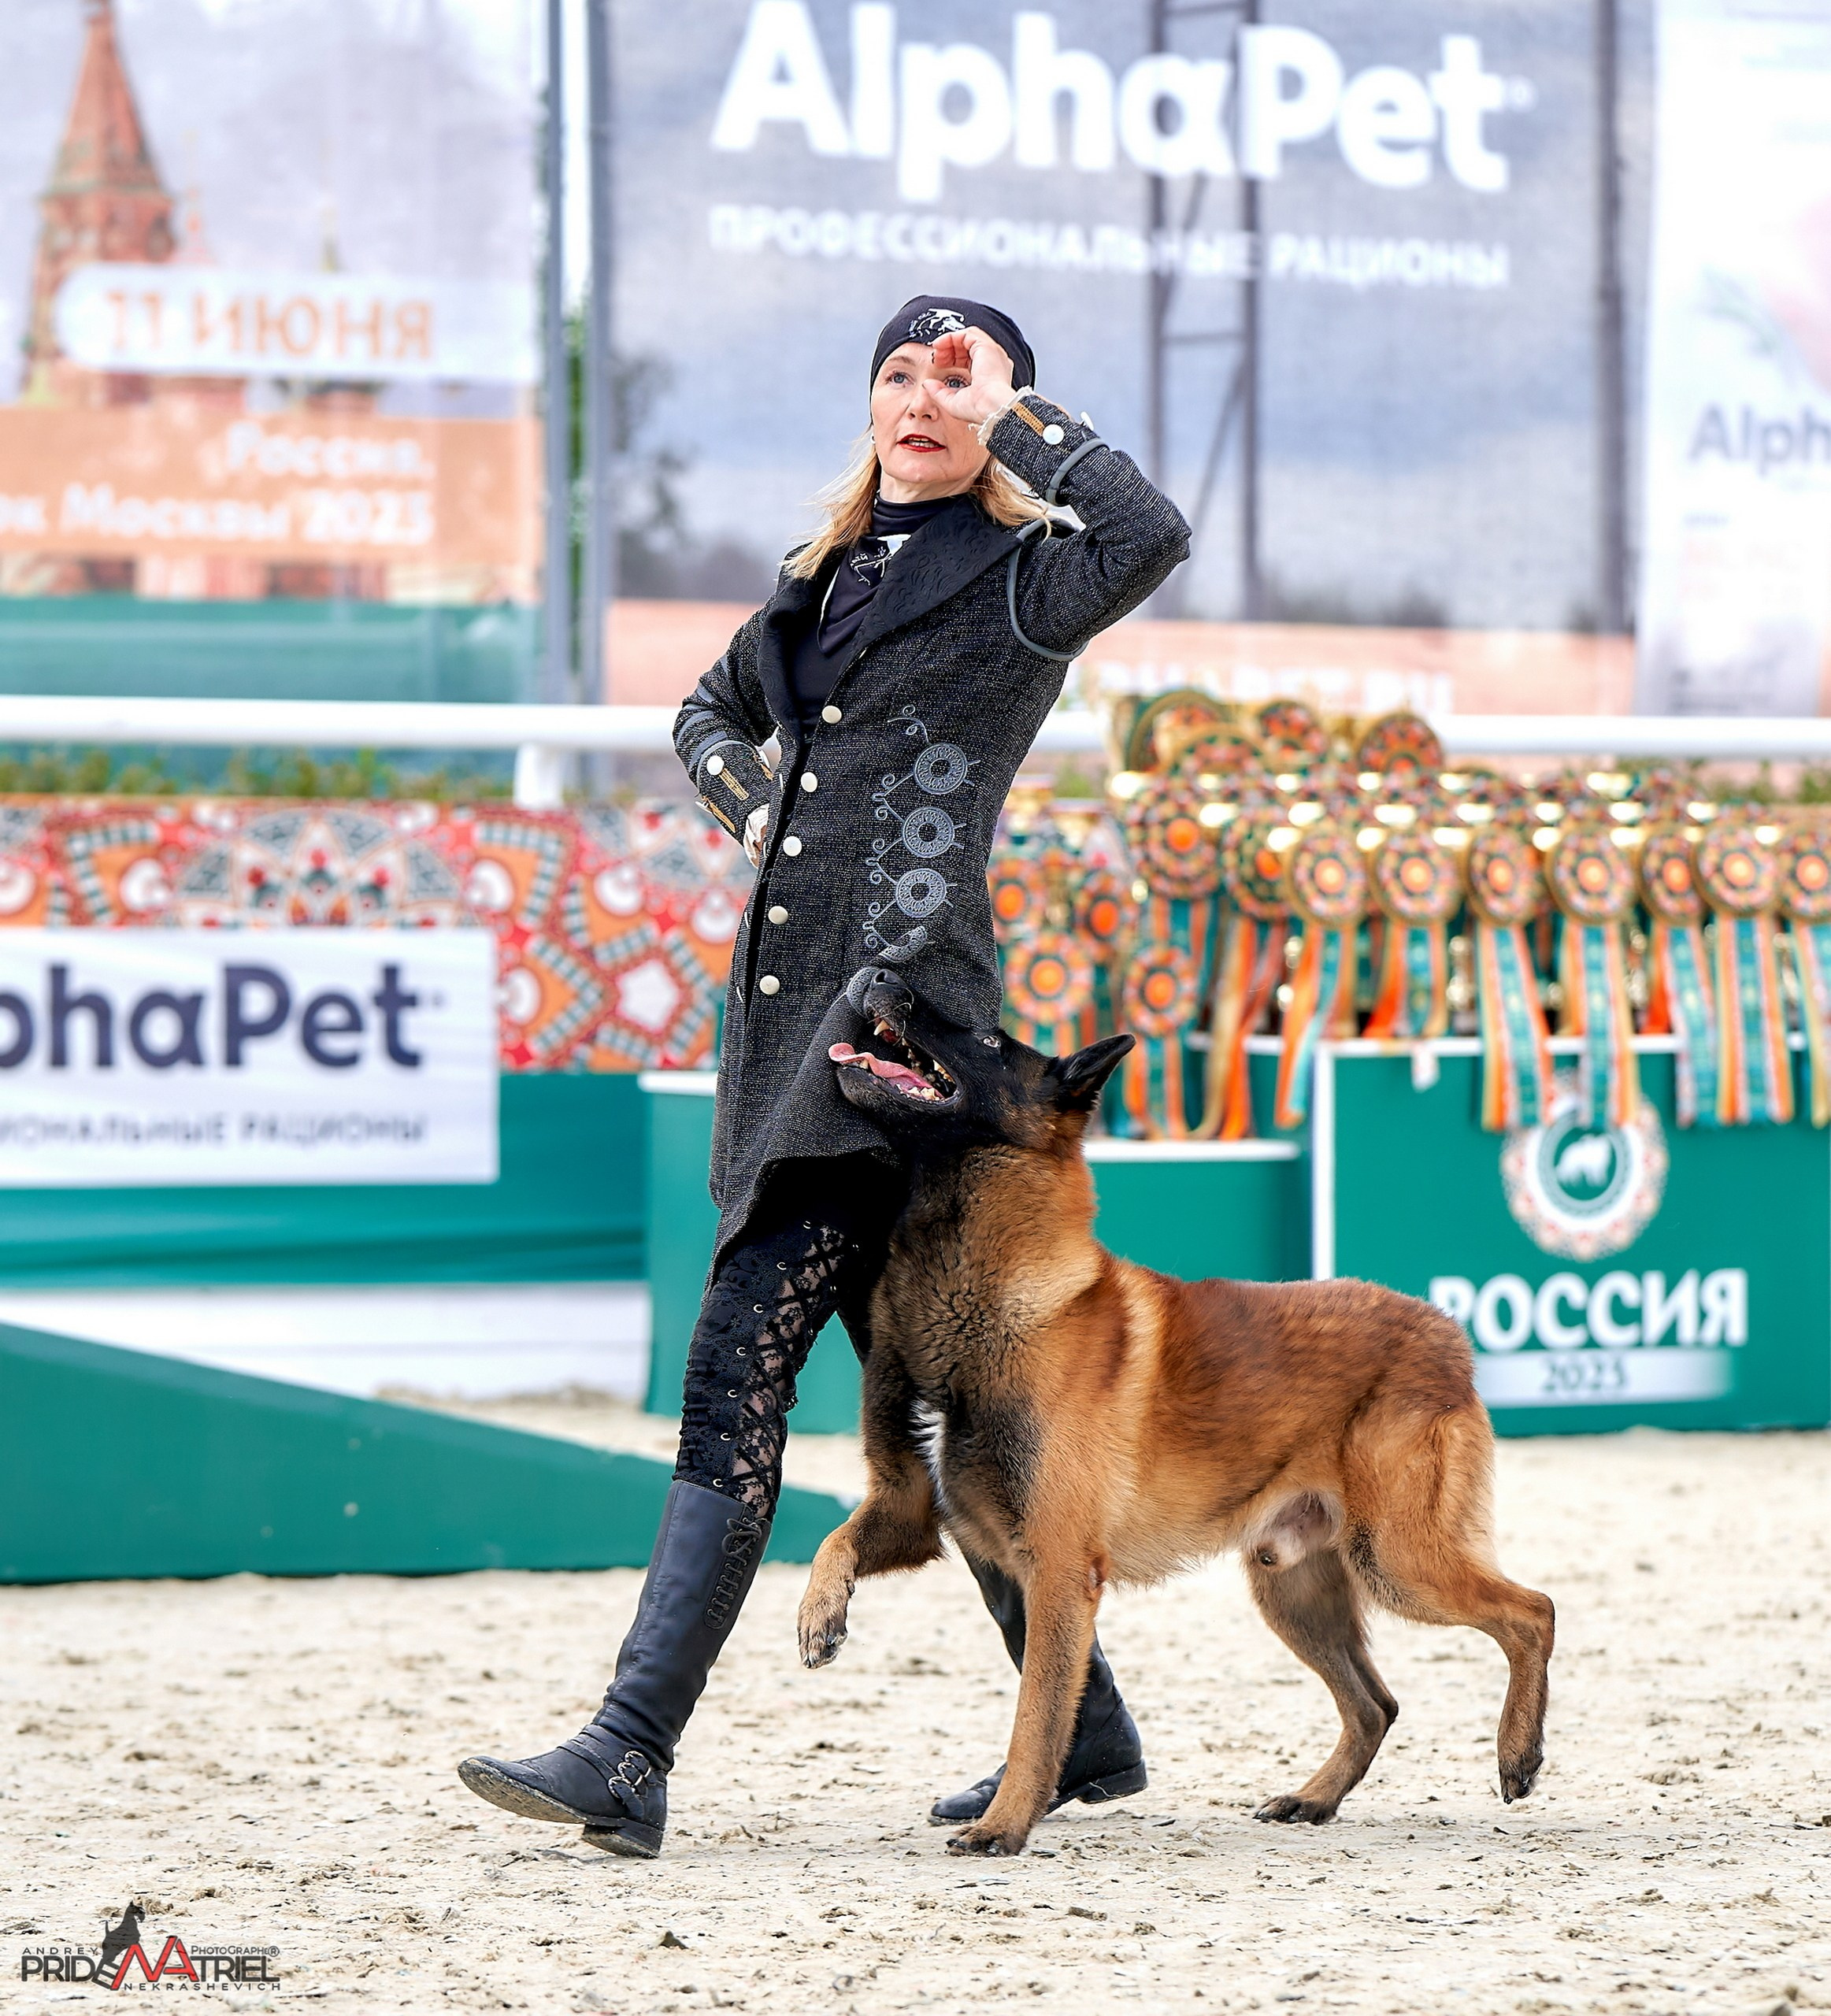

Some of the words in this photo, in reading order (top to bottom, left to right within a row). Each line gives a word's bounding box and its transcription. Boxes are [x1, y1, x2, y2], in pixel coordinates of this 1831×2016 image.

[710, 0, 1509, 202] AlphaPet
[708, 204, 1261, 279] ПРОФЕССИОНАЛЬНЫЕ
[1268, 233, 1507, 287] РАЦИОНЫ
[107, 291, 160, 350] 11
[192, 295, 432, 360] ИЮНЯ
[1686, 402, 1831, 479] Alph
[61, 484, 290, 540] Москвы
[240, 1111, 429, 1149] РАЦИОНЫ
[1429, 1268, 1748, 1351] РОССИЯ
